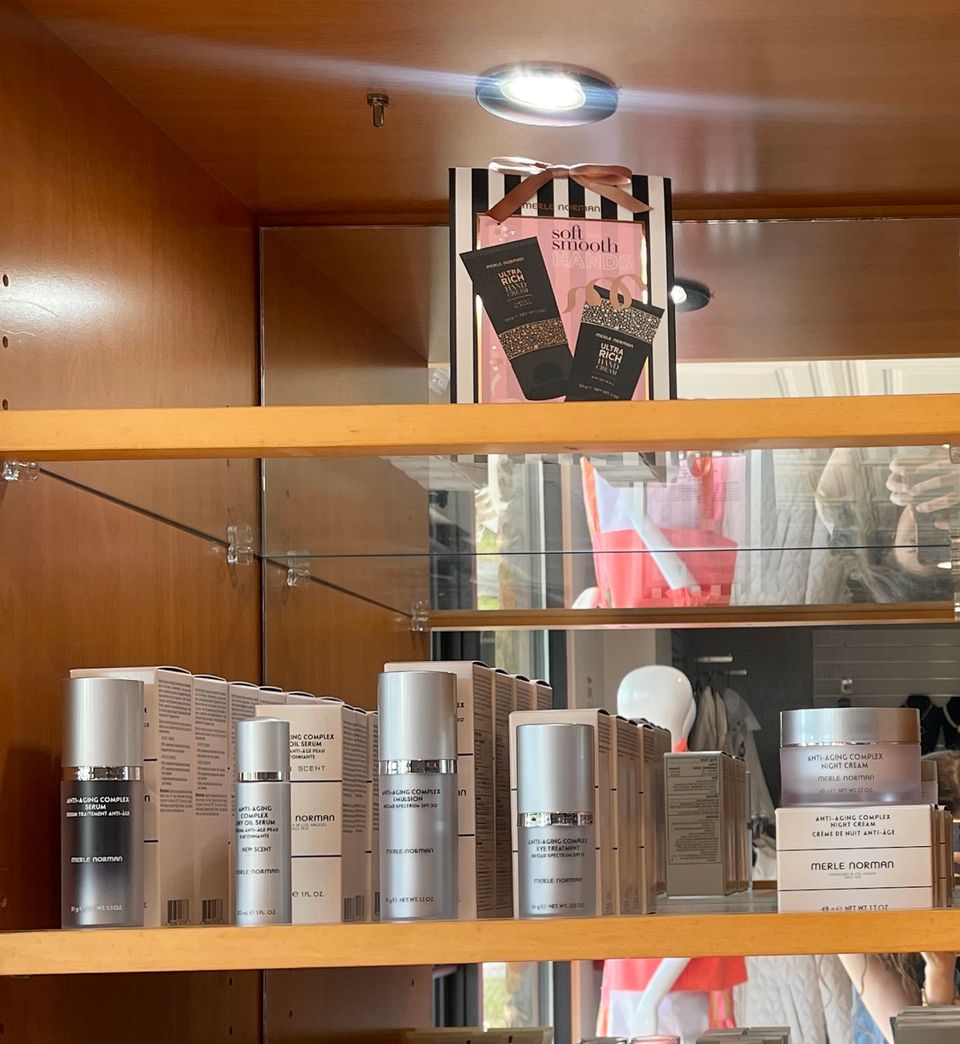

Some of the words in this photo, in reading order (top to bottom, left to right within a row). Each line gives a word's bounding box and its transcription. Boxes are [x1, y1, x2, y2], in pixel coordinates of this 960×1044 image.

[551, 224, 582, 240] soft
[551, 237, 618, 253] smooth
[553, 252, 632, 270] HANDS
[498, 268, 522, 278] ULTRA
[500, 274, 525, 286] RICH
[600, 342, 624, 356] ULTRA
[599, 349, 623, 363] RICH
[807, 753, 848, 762] ANTI-AGING
[849, 753, 883, 761] COMPLEX
[821, 762, 842, 770] NIGHT
[295, 814, 335, 822] NORMAN
[811, 861, 845, 871] MERLE
[849, 860, 894, 870] NORMAN
